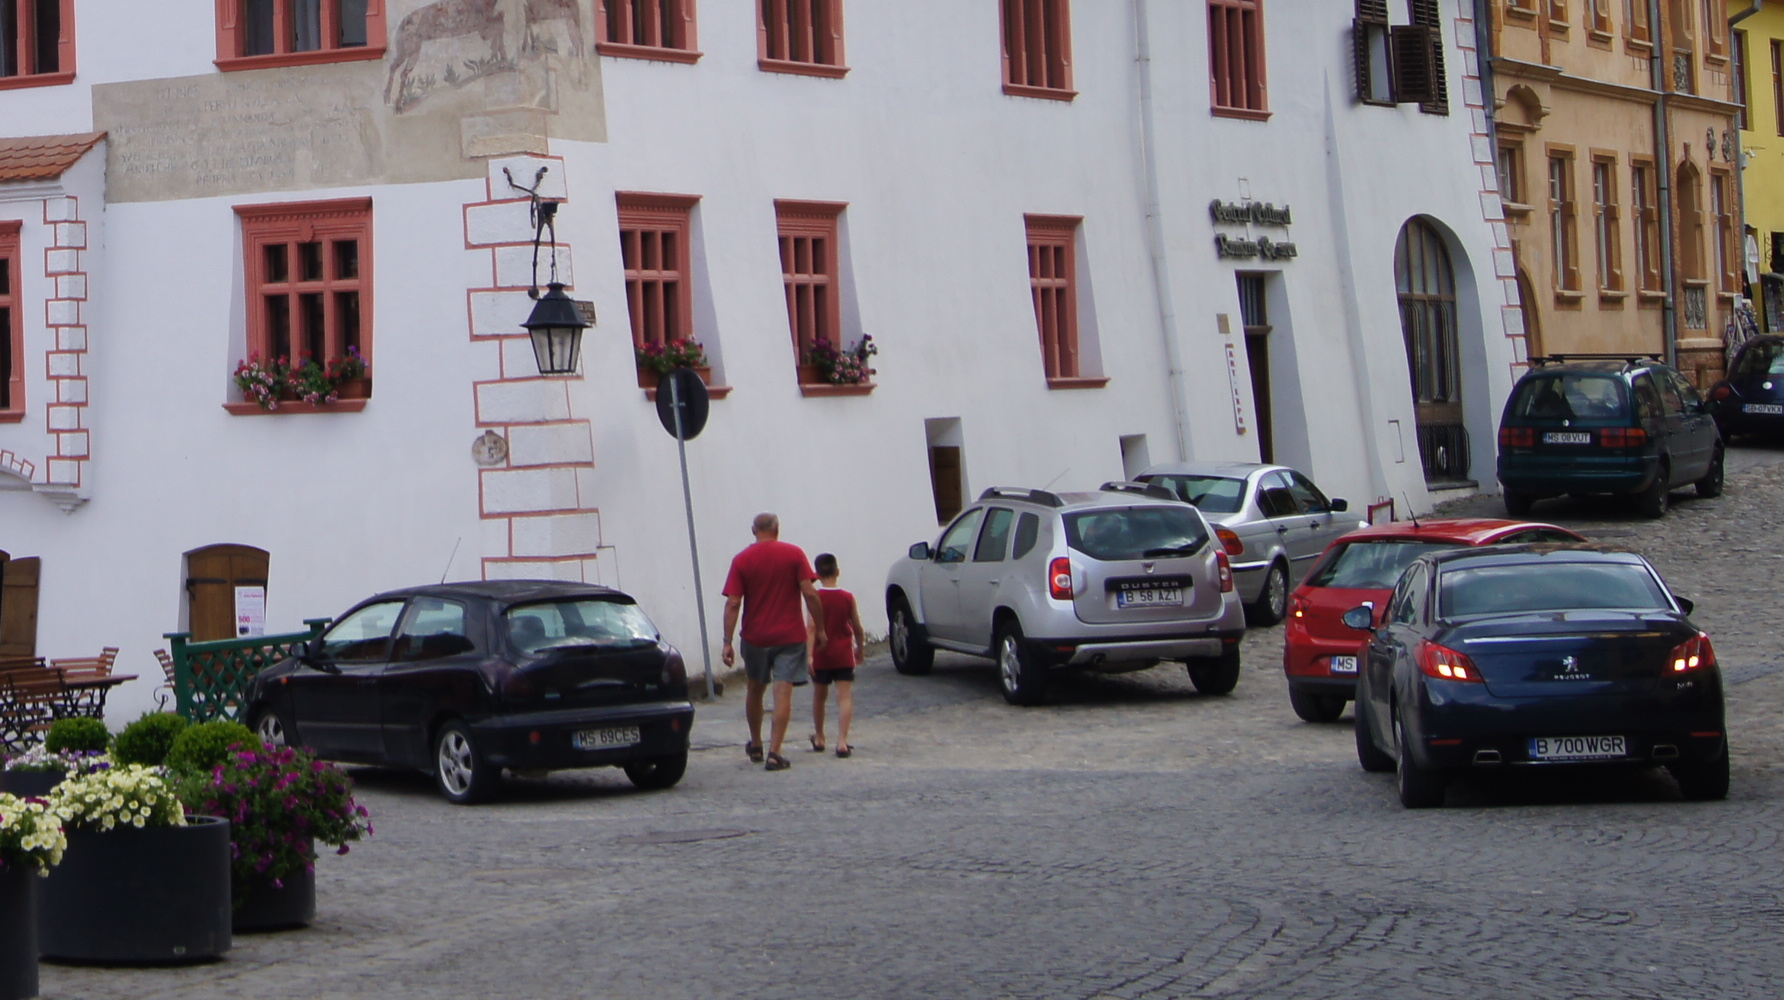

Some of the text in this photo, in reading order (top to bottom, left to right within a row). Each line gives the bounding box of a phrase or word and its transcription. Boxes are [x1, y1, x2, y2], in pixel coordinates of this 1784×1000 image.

[1120, 581, 1179, 590] DUSTER
[1126, 591, 1135, 602] B
[1337, 657, 1354, 670] MS
[1553, 673, 1591, 681] PEUGEOT
[1536, 740, 1548, 754] B
